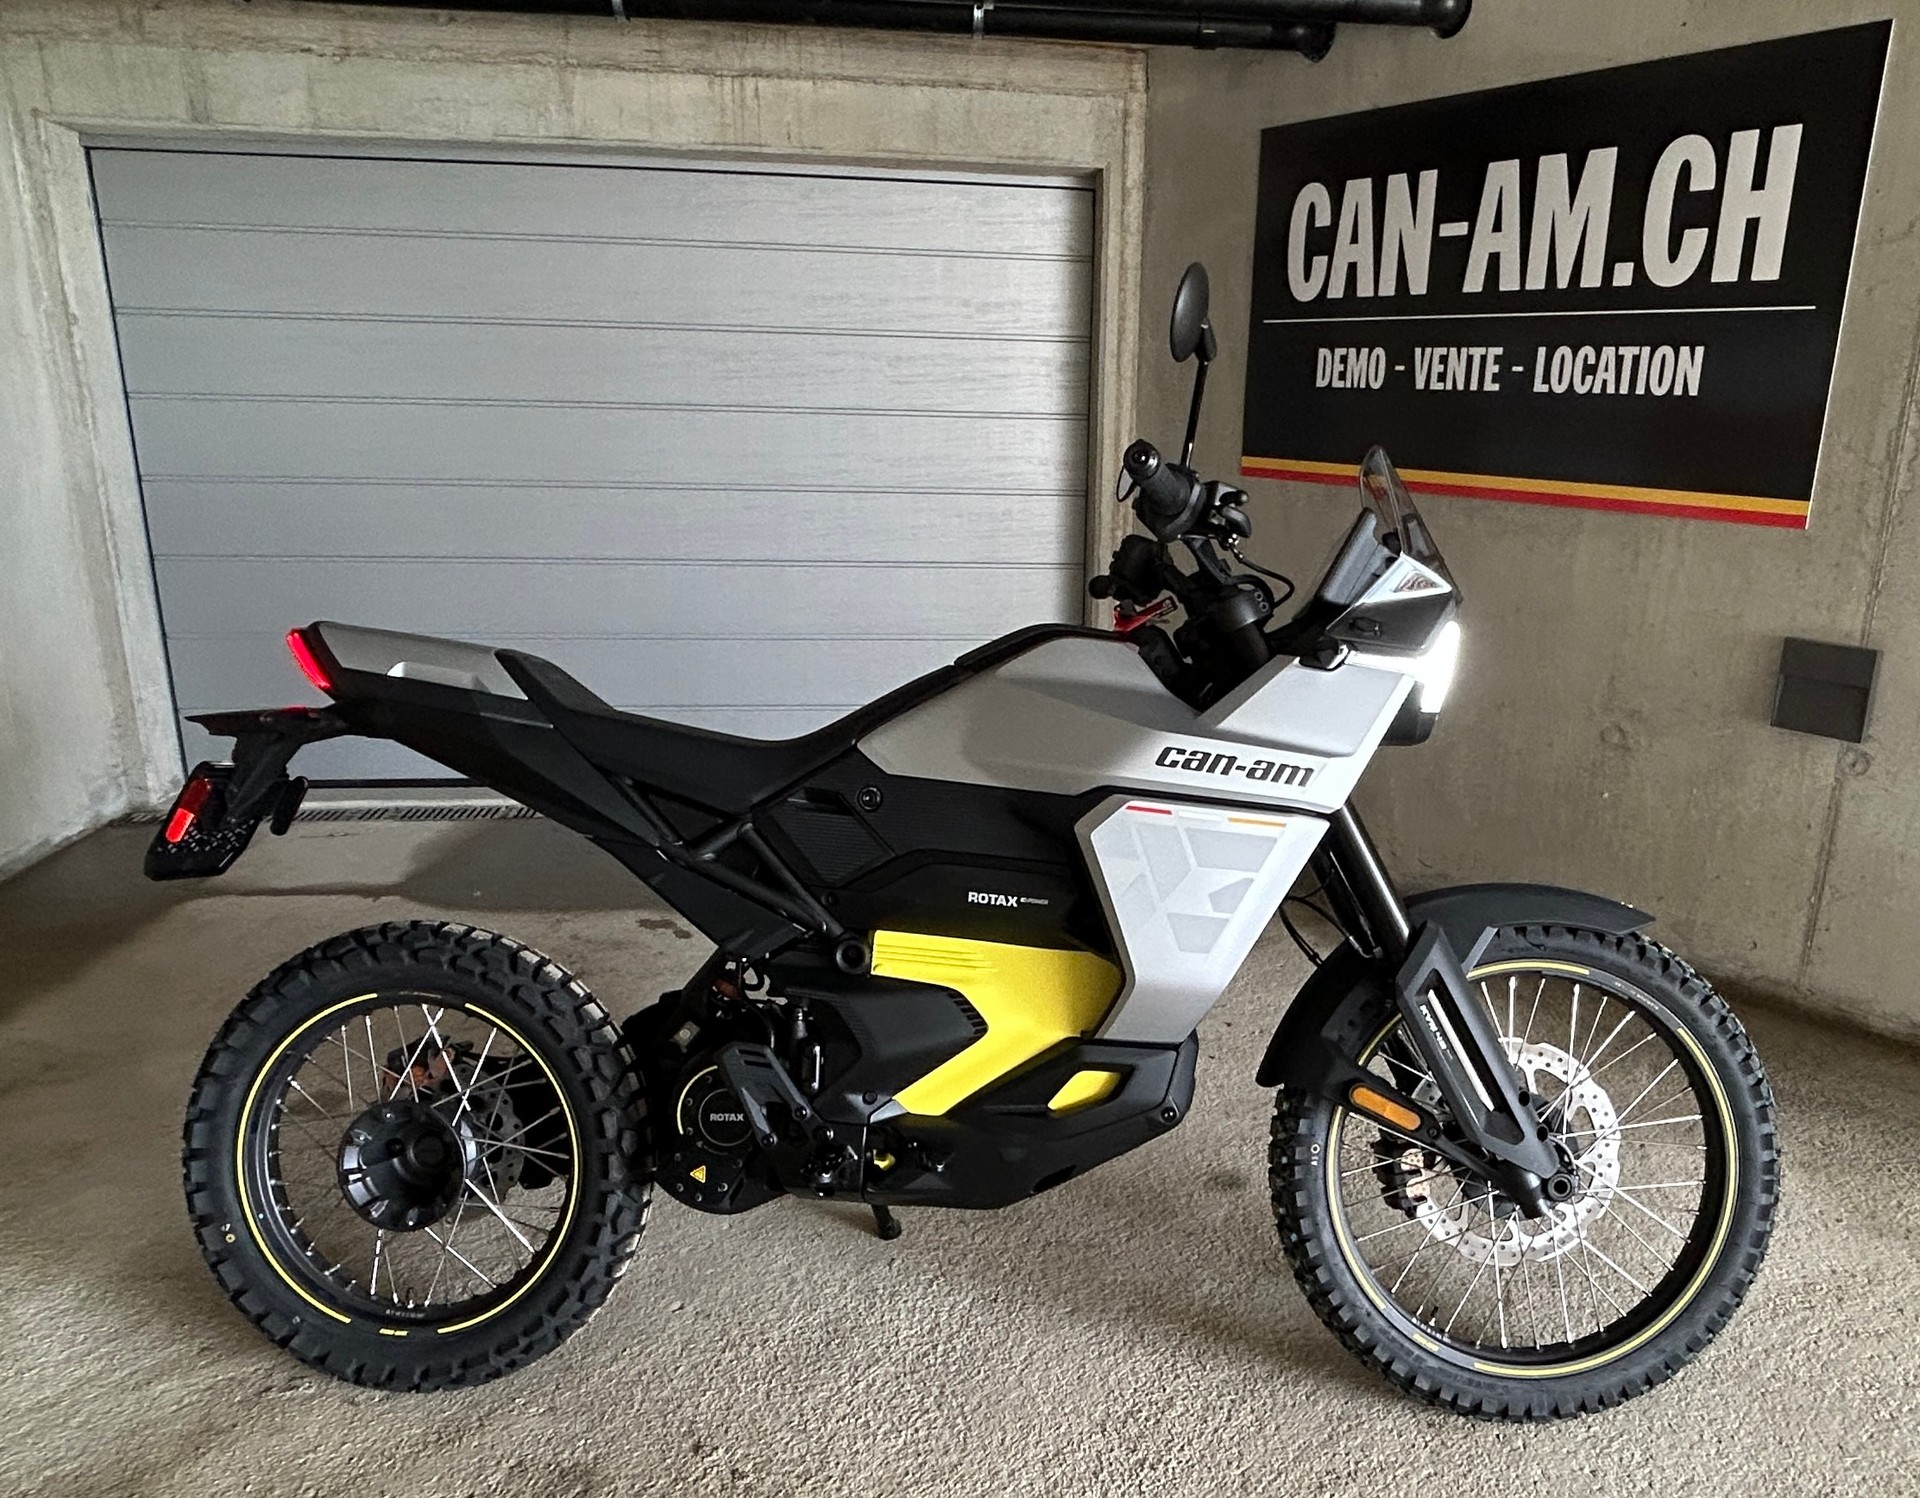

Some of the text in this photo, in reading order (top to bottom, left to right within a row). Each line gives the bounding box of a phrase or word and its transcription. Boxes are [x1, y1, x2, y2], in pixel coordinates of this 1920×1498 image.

[1287, 124, 1804, 302] CAN-AM.CH
[1315, 347, 1387, 390] DEMO
[1414, 346, 1504, 392] VENTE
[1532, 345, 1705, 397] LOCATION
[1155, 746, 1315, 788] can-am
[967, 891, 1018, 908] ROTAX
[709, 1112, 745, 1122] ROTAX
